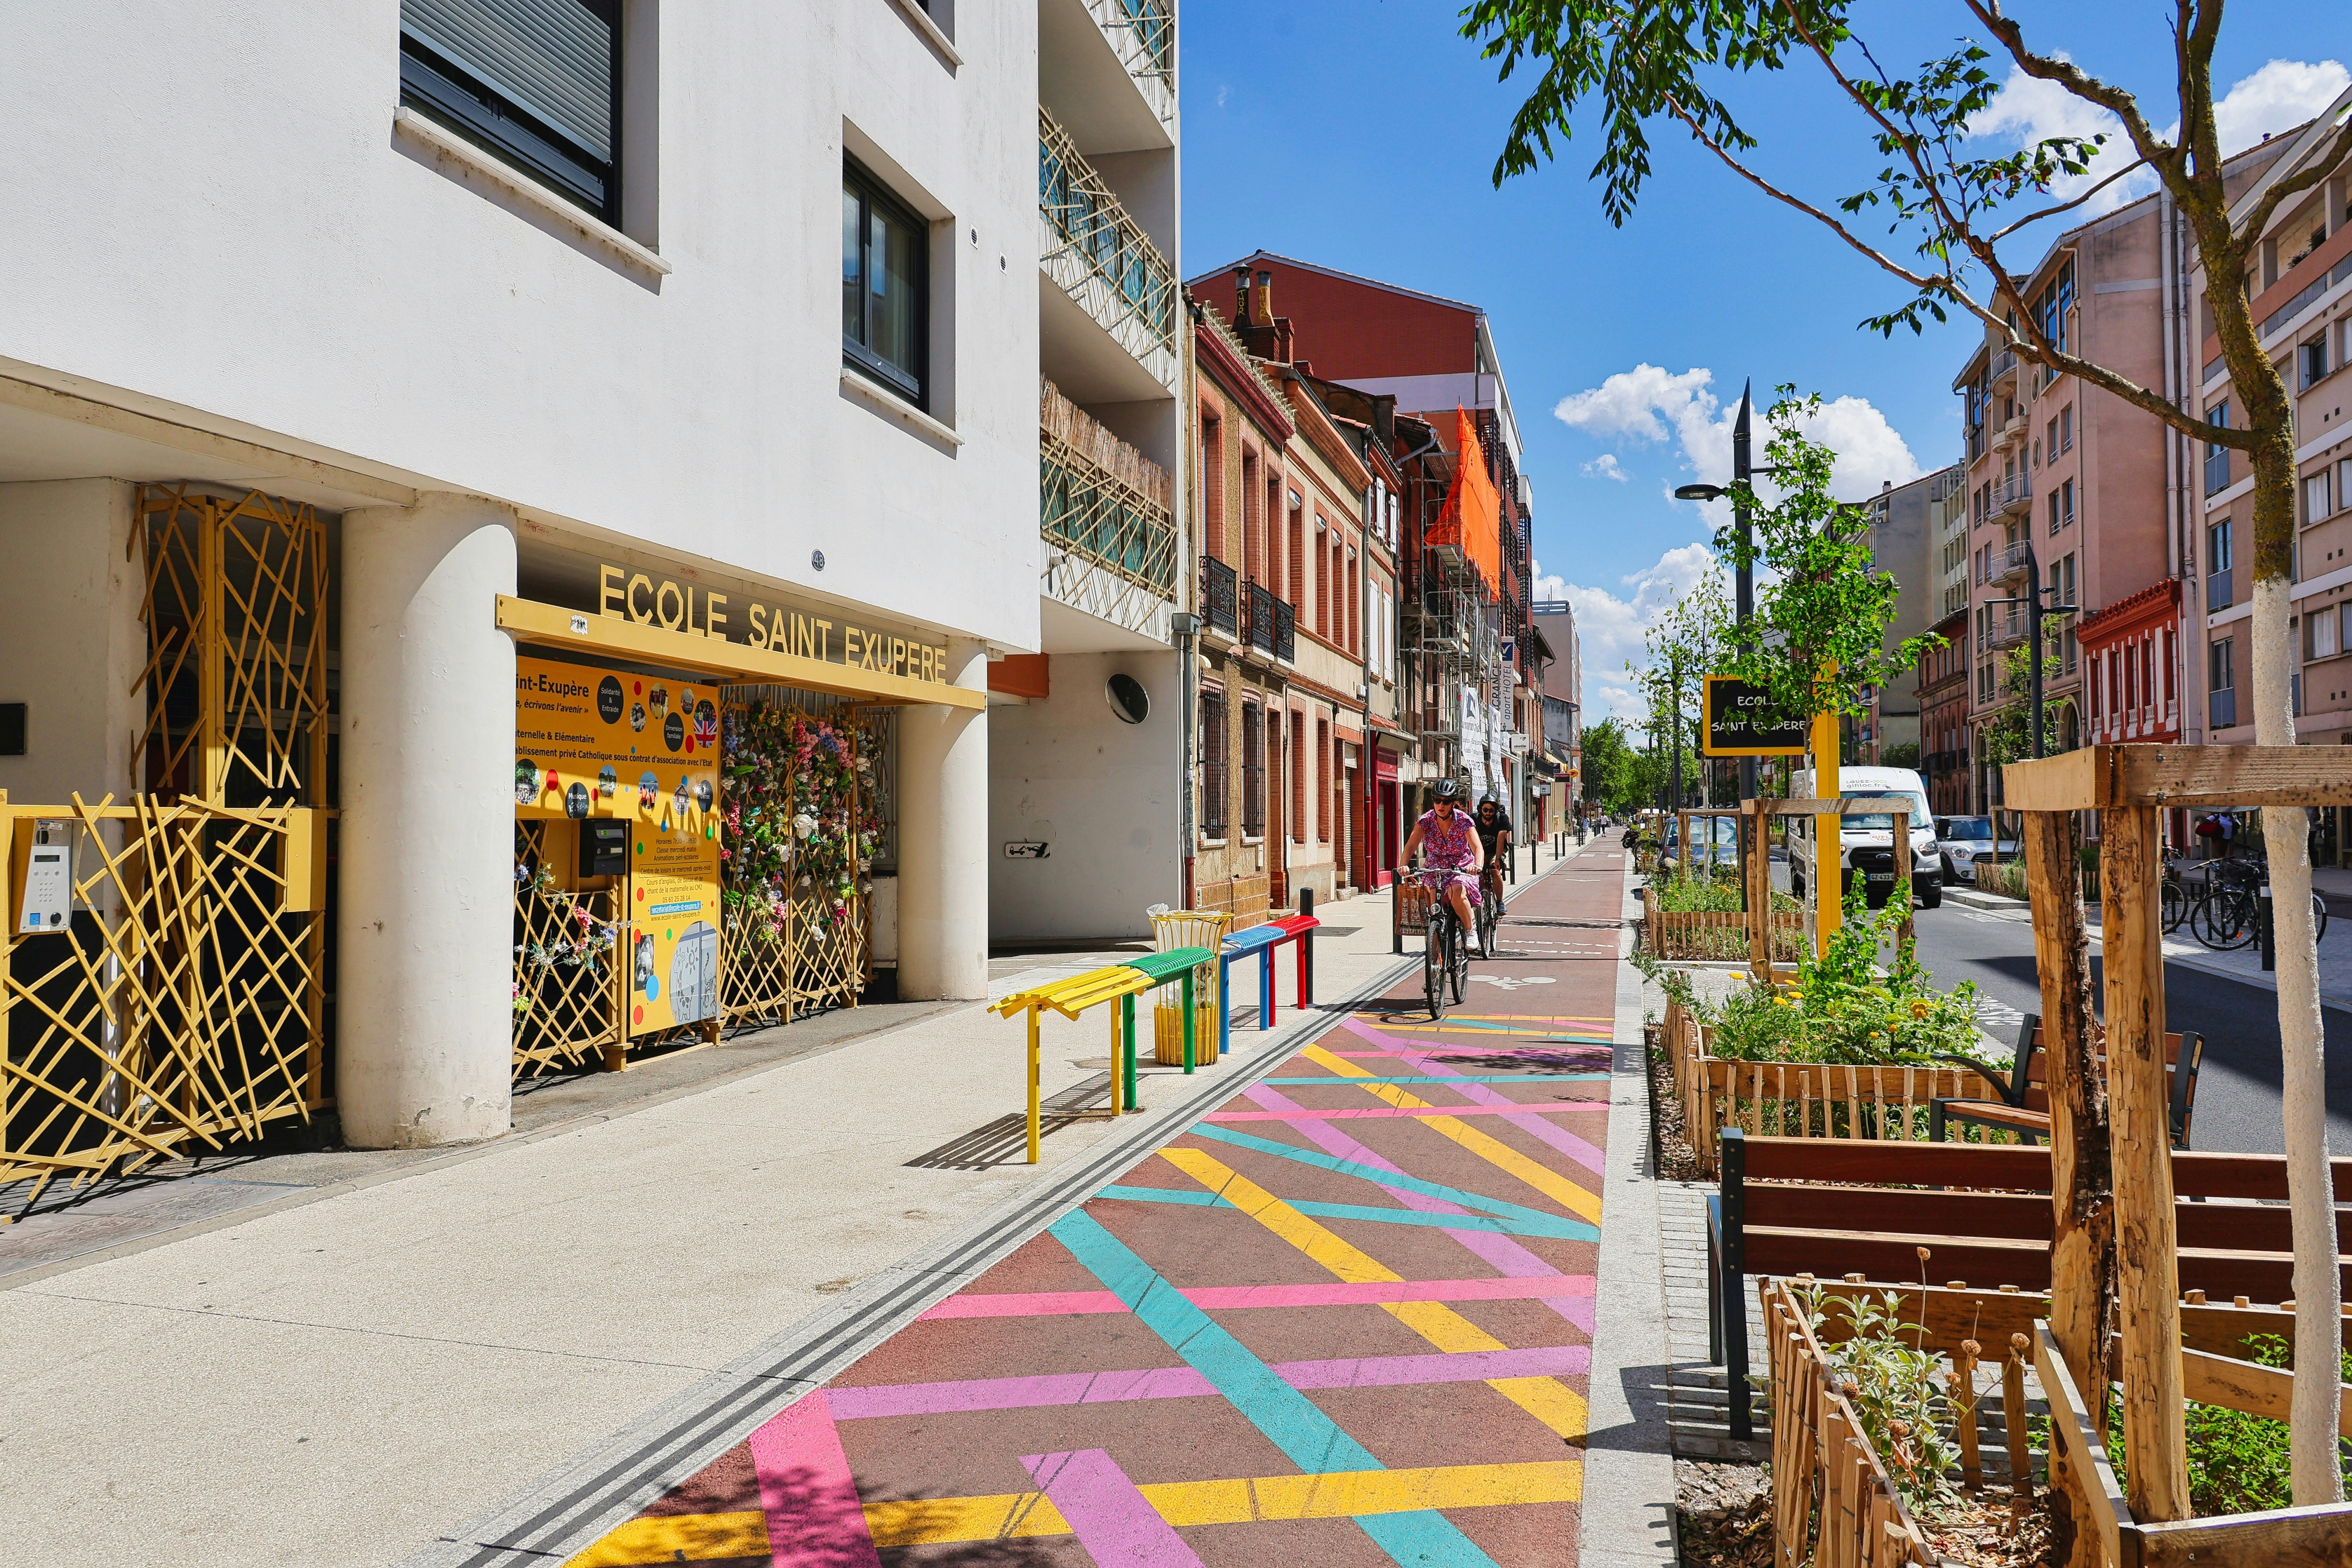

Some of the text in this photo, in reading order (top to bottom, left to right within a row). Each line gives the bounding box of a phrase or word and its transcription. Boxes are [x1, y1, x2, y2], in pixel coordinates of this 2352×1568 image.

[814, 554, 823, 566] 48
[601, 564, 946, 685] ECOLE SAINT EXUPERE
[516, 674, 588, 698] int-Exupère
[601, 687, 620, 696] Solidarité
[524, 699, 555, 711] écrivons
[556, 703, 582, 713] l'avenir
[1711, 722, 1748, 731] SANT
[516, 729, 595, 743] ternelle & Elémentaire
[516, 746, 557, 757] ablissement
[559, 749, 576, 758] privé
[578, 750, 612, 761] Catholique
[652, 756, 686, 765] d'association
